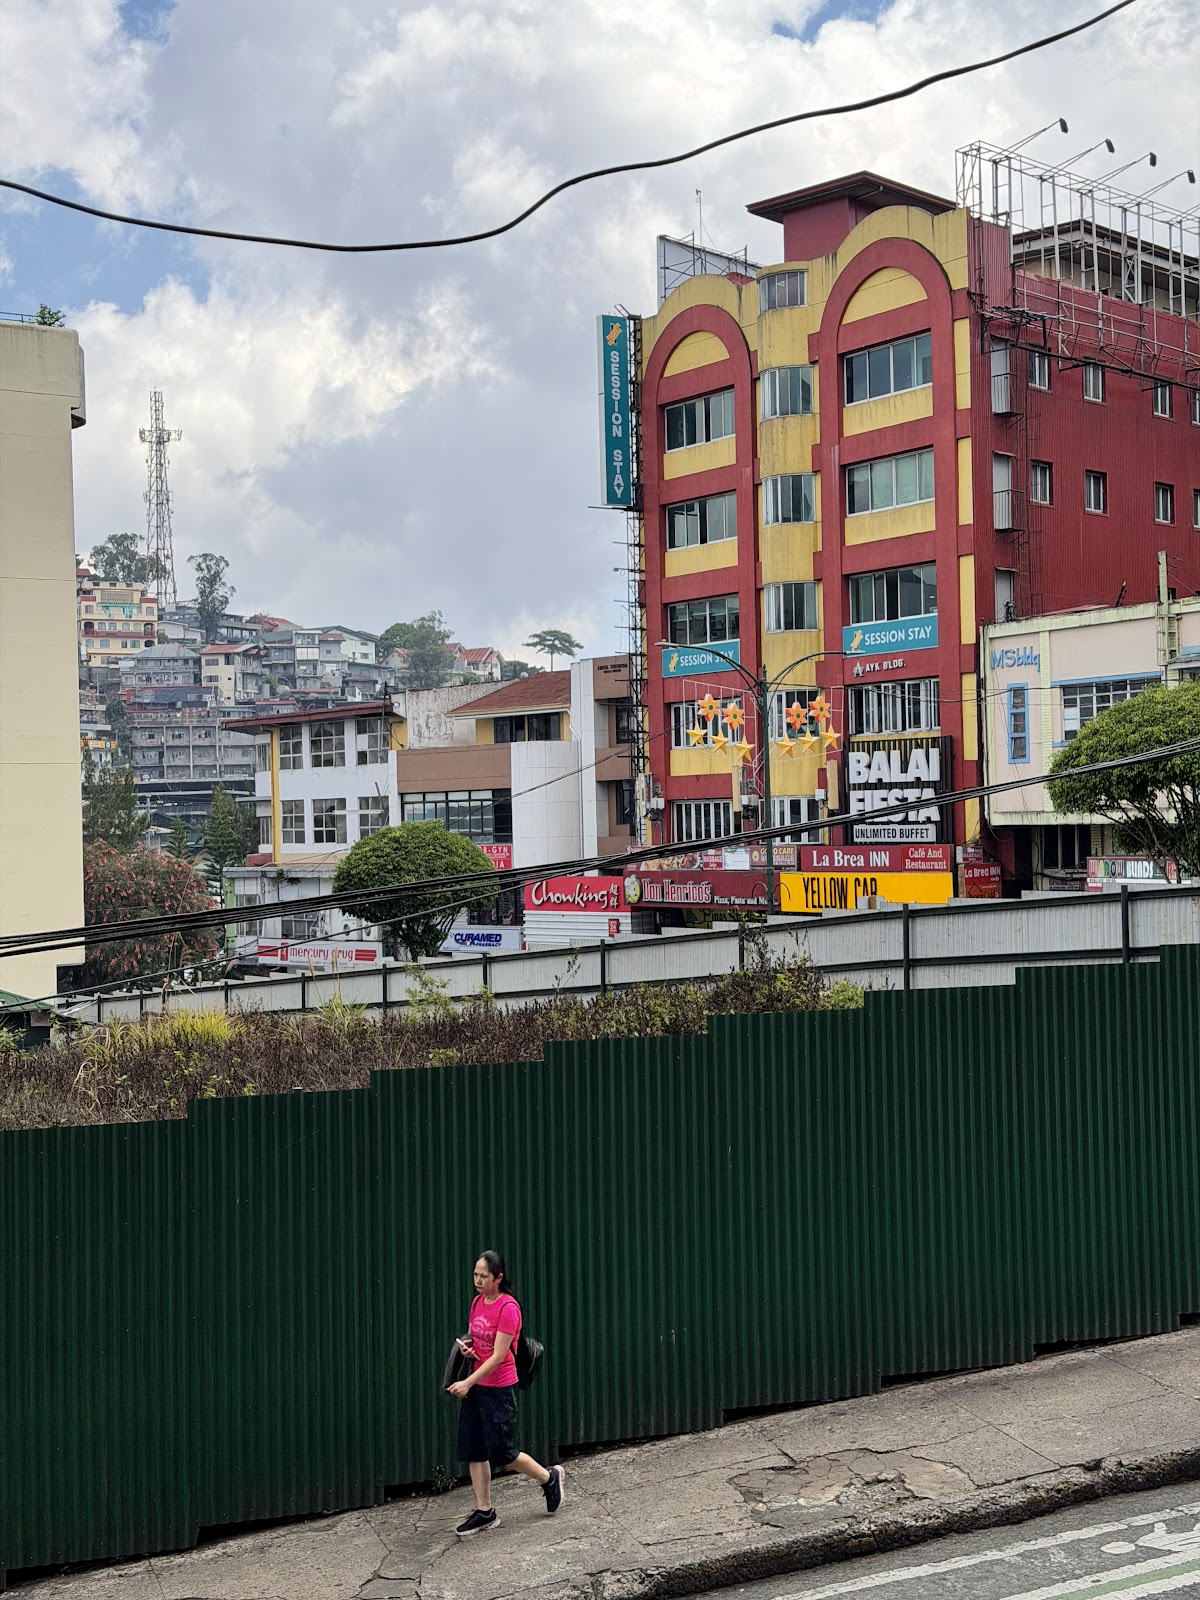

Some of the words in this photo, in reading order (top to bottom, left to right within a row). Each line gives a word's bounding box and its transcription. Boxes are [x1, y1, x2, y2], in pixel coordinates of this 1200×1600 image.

[610, 351, 623, 437] SESSION
[613, 449, 625, 498] STAY
[864, 629, 905, 645] SESSION
[908, 626, 932, 640] STAY
[680, 653, 712, 667] SESSION
[865, 662, 880, 673] AYK
[849, 748, 940, 784] BALAI
[849, 788, 941, 822] FIESTA
[855, 828, 897, 839] UNLIMITED
[899, 828, 930, 839] BUFFET
[812, 850, 830, 867] La
[833, 850, 865, 867] Brea
[869, 851, 890, 867] INN
[908, 848, 926, 858] Café
[927, 848, 943, 858] And
[905, 859, 947, 869] Restaurant
[964, 869, 973, 878] La
[974, 868, 989, 878] Brea
[990, 866, 1001, 876] INN
[1126, 860, 1153, 878] BLINDS
[531, 880, 608, 909] Chowking
[641, 878, 662, 901] Don
[802, 877, 848, 909] YELLOW
[454, 933, 502, 946] CURAMED
[289, 948, 329, 960] mercury
[331, 947, 354, 961] drug
